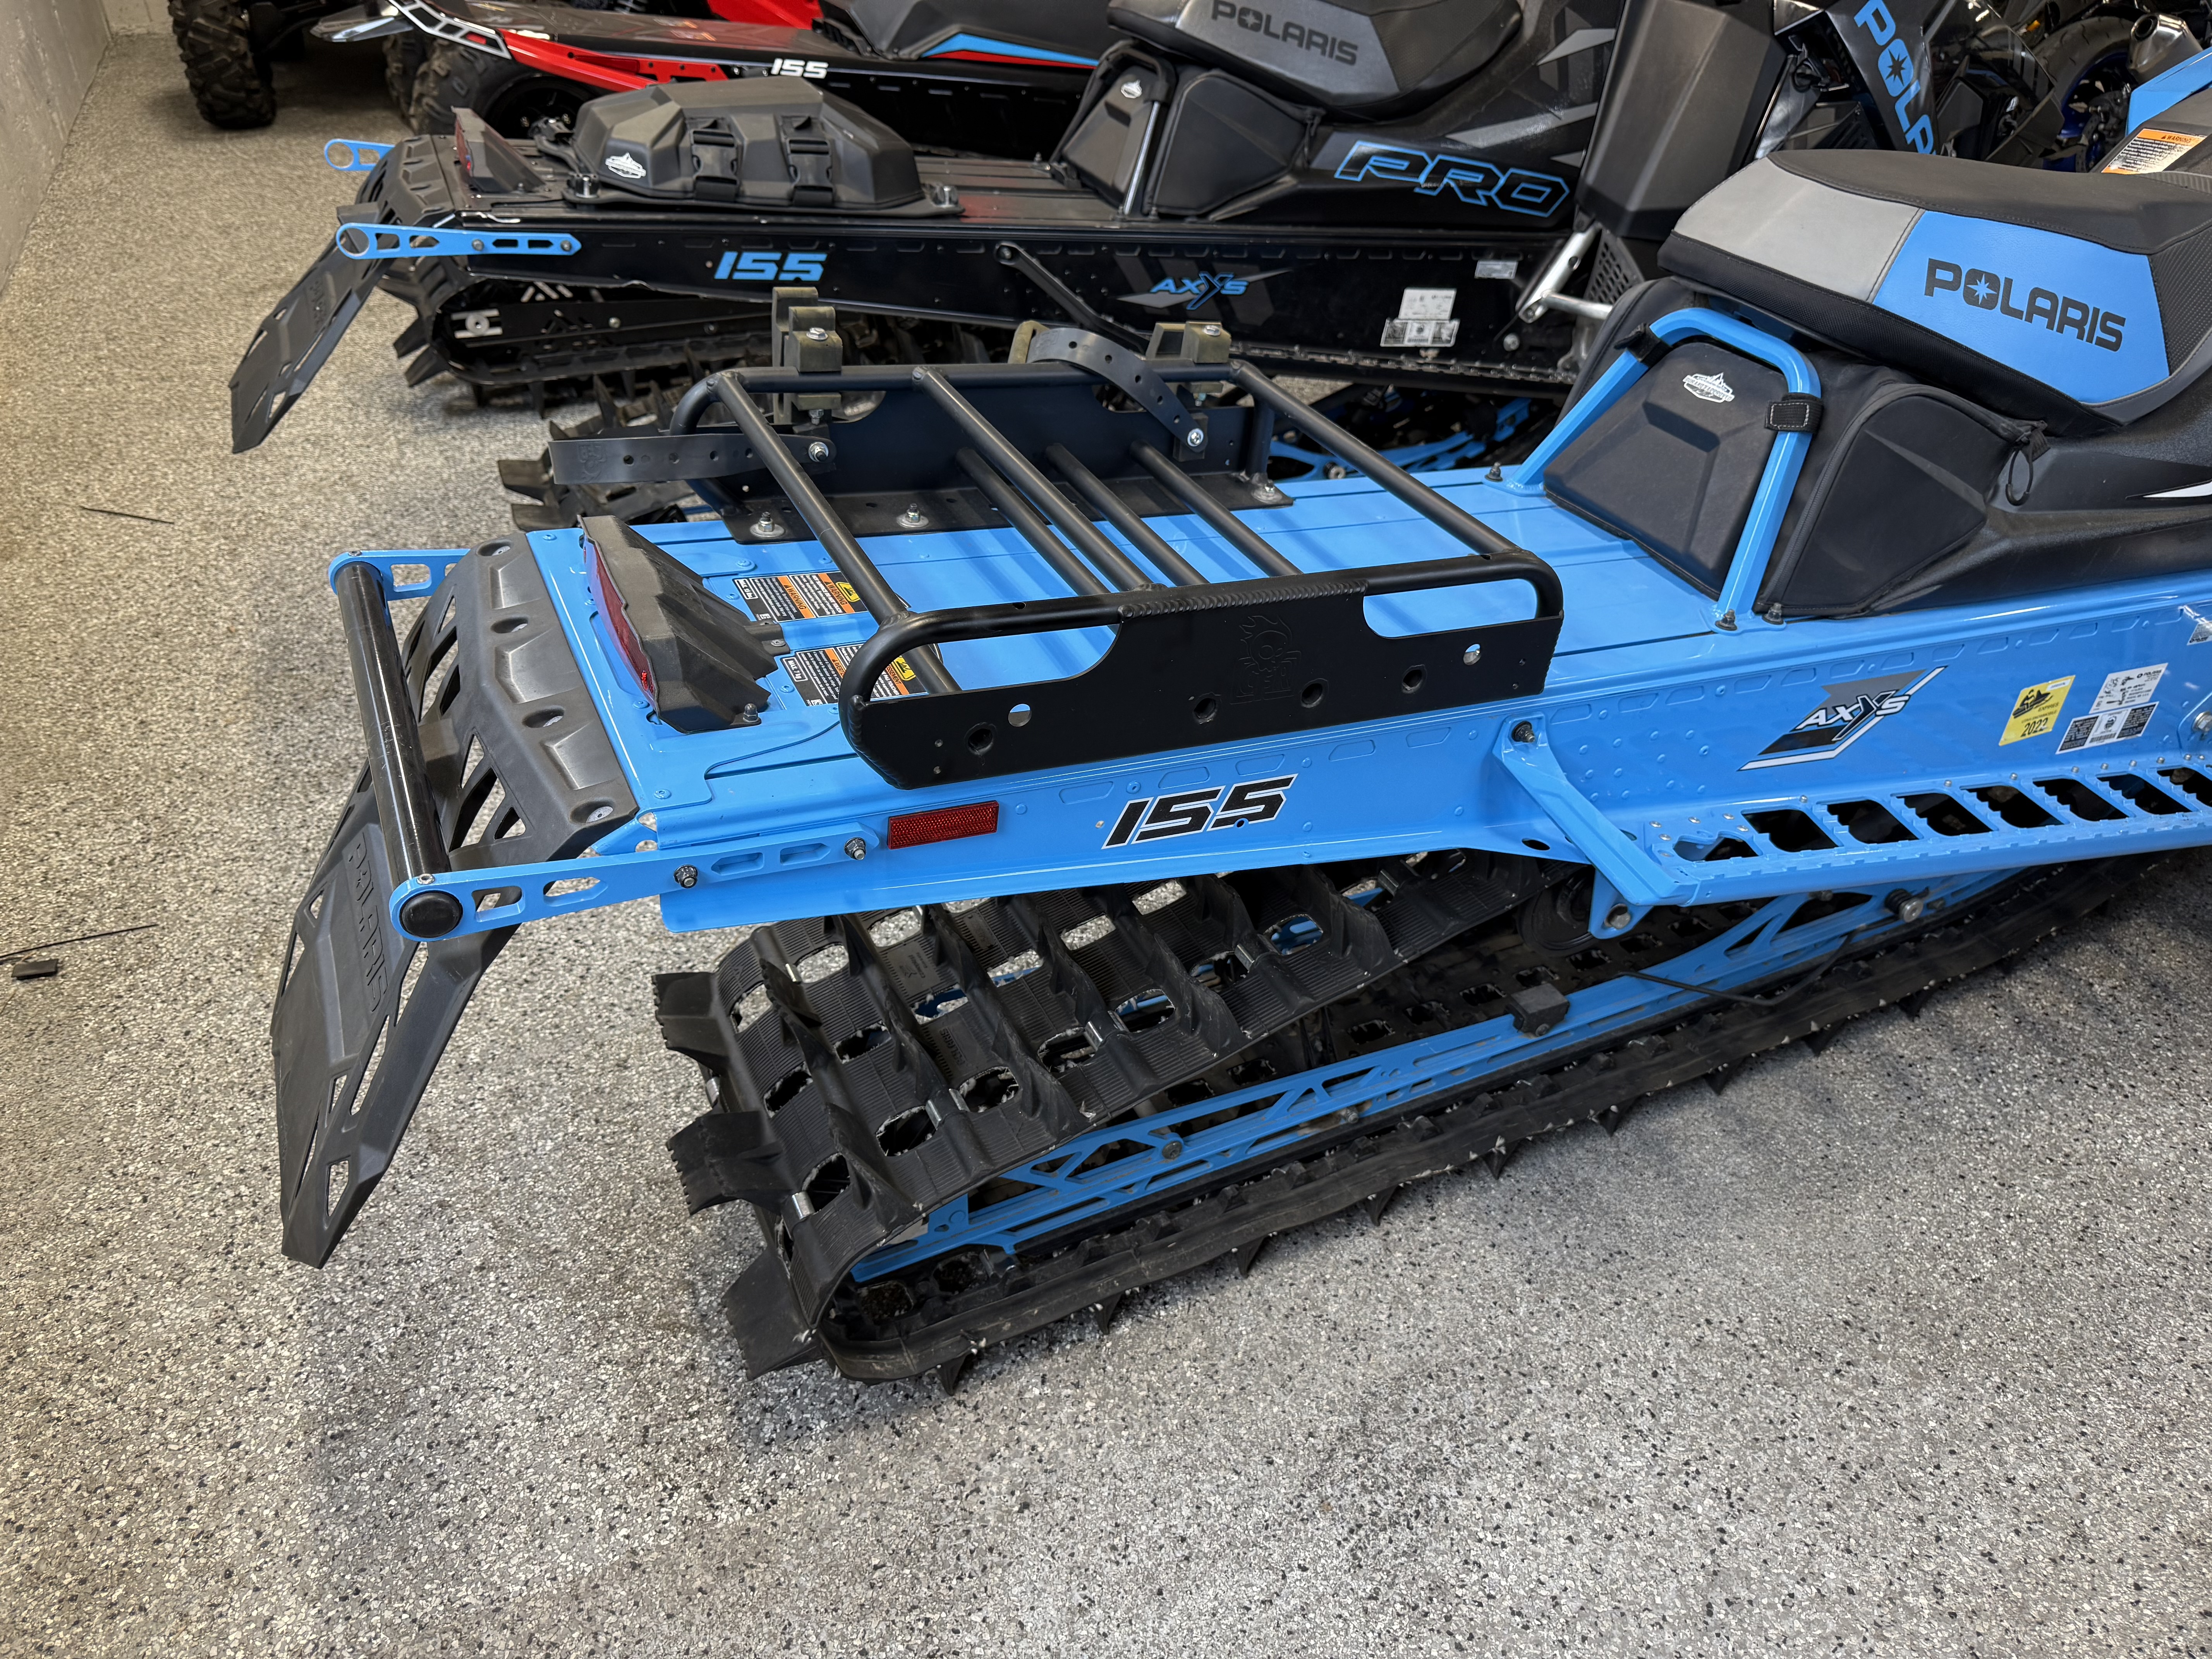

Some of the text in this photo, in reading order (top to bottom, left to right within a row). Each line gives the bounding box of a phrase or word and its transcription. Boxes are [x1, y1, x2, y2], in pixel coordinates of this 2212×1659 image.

[1211, 0, 1358, 66] POLARIS
[770, 58, 829, 79] 155
[1854, 0, 1936, 154] POLA
[1334, 141, 1570, 218] PRO
[714, 251, 828, 282] 155
[1150, 271, 1250, 311] AXYS
[1924, 258, 2126, 352] POLARIS
[787, 587, 807, 610] WARNING
[829, 584, 848, 605] WARNING
[1790, 689, 1910, 742] AXYS
[2020, 717, 2048, 738] 2022
[1101, 773, 1298, 850] 155
[348, 832, 388, 1012] POLARIS
[939, 1028, 966, 1066] POLARIS
